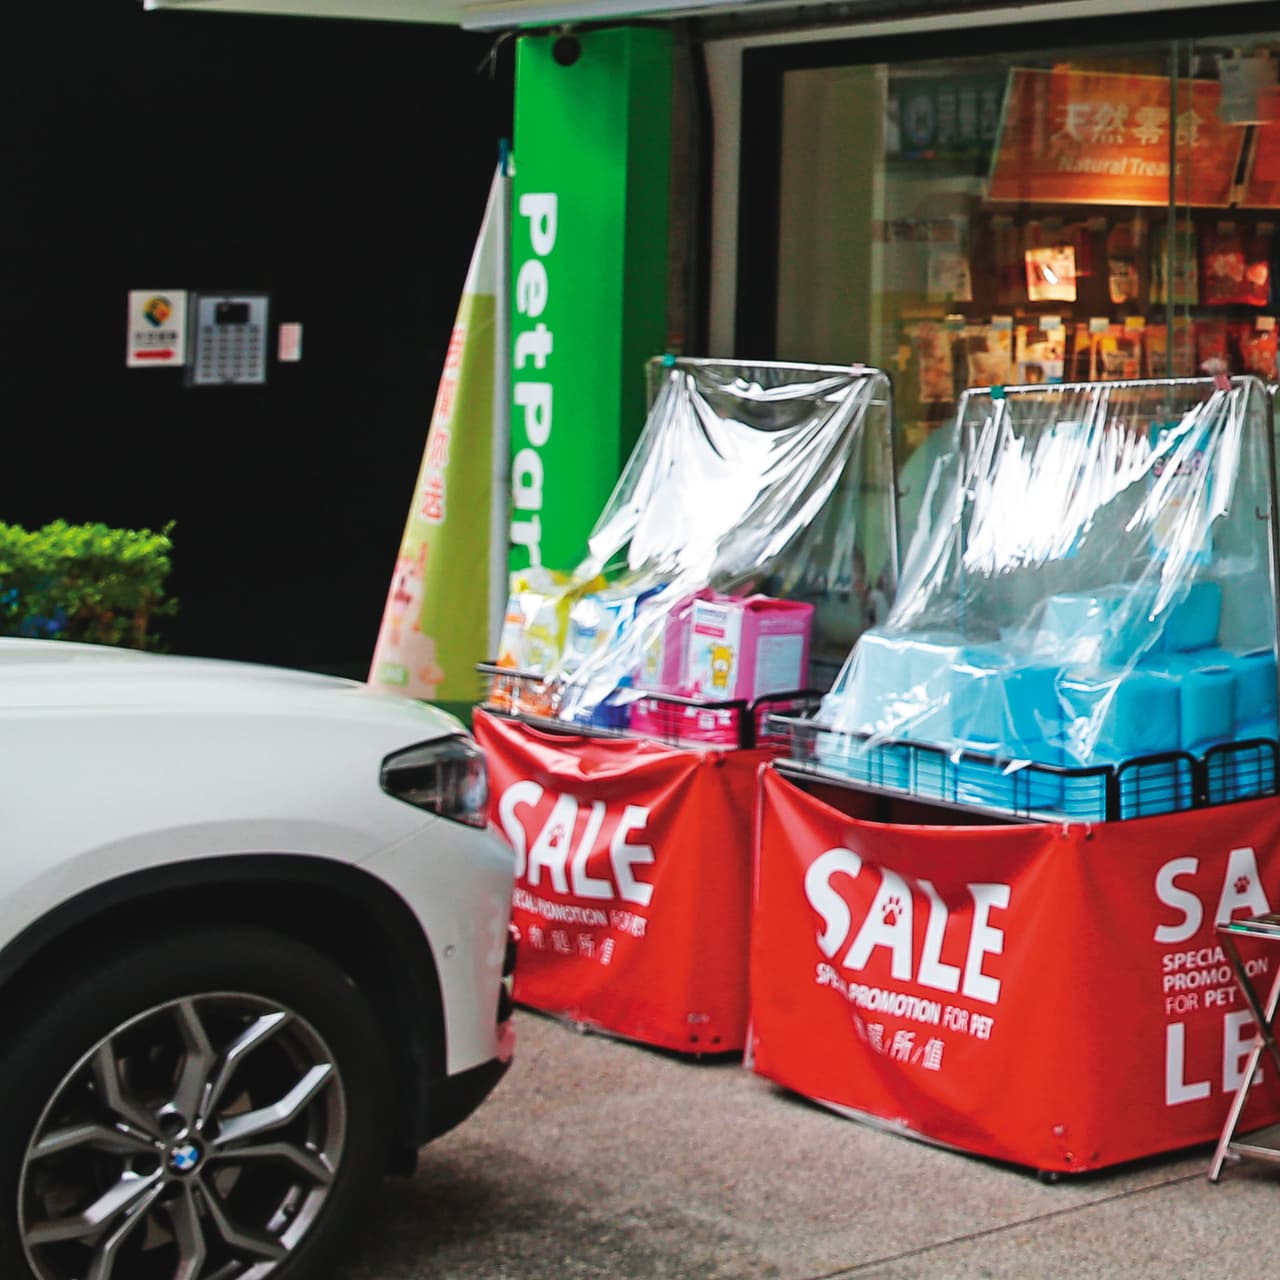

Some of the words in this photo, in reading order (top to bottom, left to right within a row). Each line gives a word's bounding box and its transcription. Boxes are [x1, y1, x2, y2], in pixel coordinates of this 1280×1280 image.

[511, 192, 558, 567] PetPar
[499, 780, 656, 907] SALE
[804, 847, 1012, 1006] SALE
[1153, 847, 1272, 944] SA
[1162, 945, 1230, 973] SPECIA
[1163, 957, 1269, 994] PROMOON
[848, 982, 942, 1026] PROMOTION
[943, 1004, 969, 1033] FOR
[968, 1012, 996, 1040] PET
[1165, 991, 1199, 1016] FOR
[1204, 986, 1238, 1009] PET
